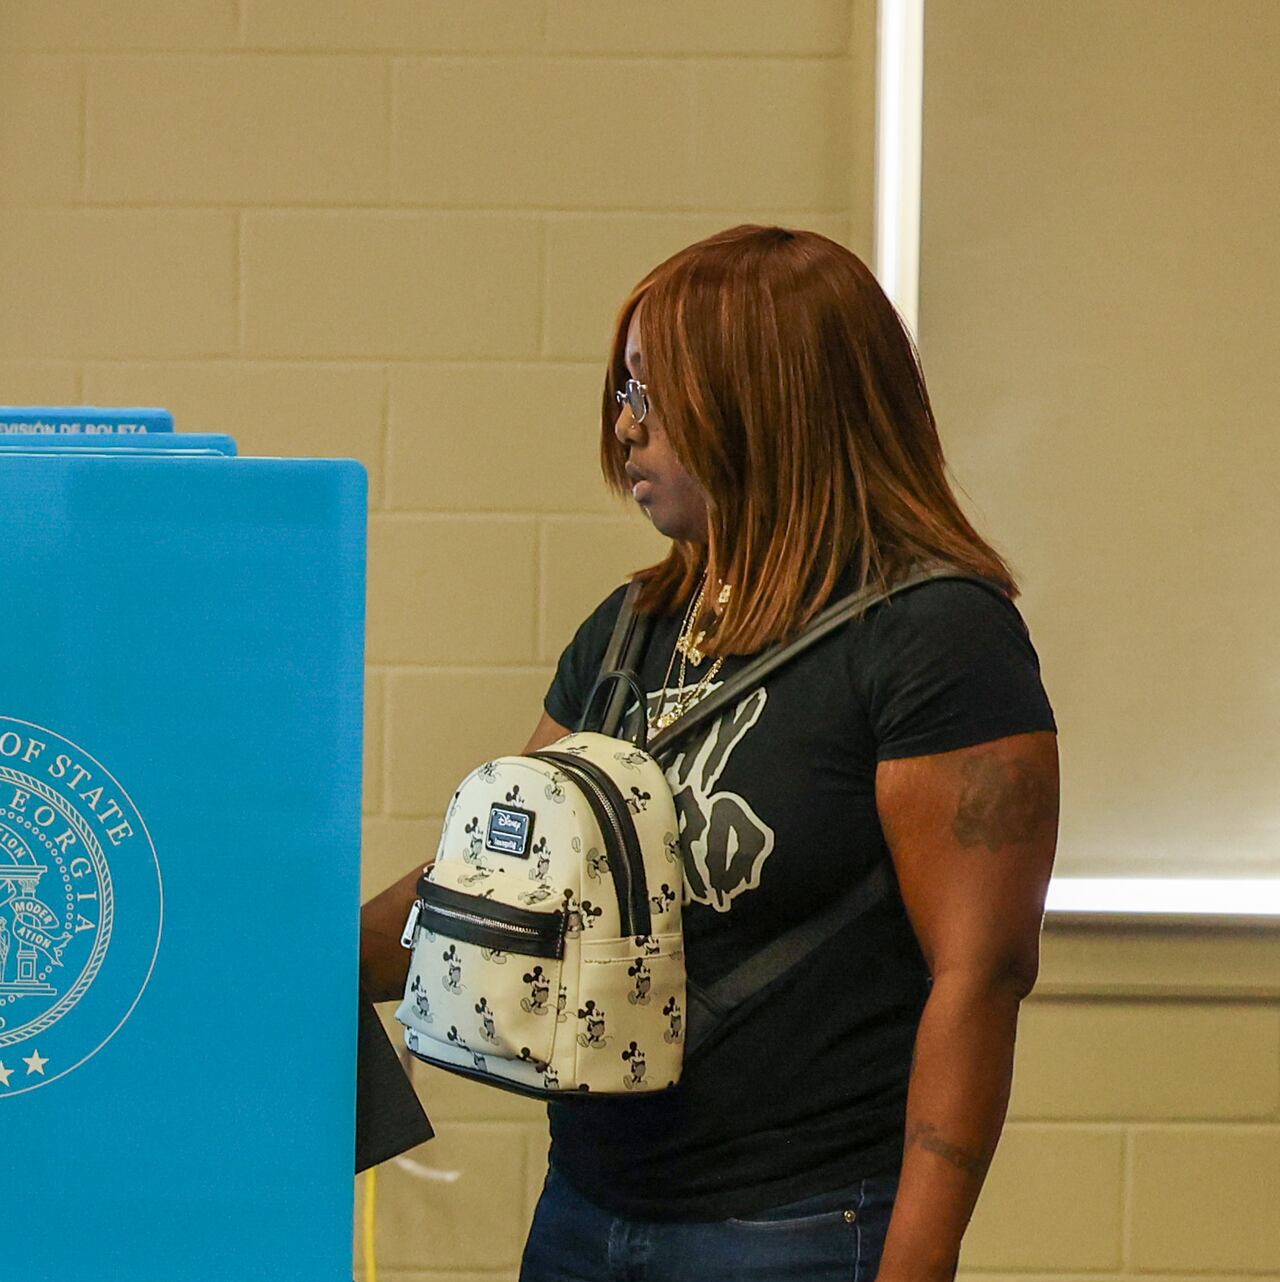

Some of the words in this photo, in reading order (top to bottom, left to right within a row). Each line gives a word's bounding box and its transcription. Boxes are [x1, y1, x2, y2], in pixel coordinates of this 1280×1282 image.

[60, 423, 80, 434] DE
[48, 754, 134, 846] STATE
[497, 812, 522, 831] Disney
[14, 902, 53, 925] MODER
[18, 927, 52, 949] ATION
